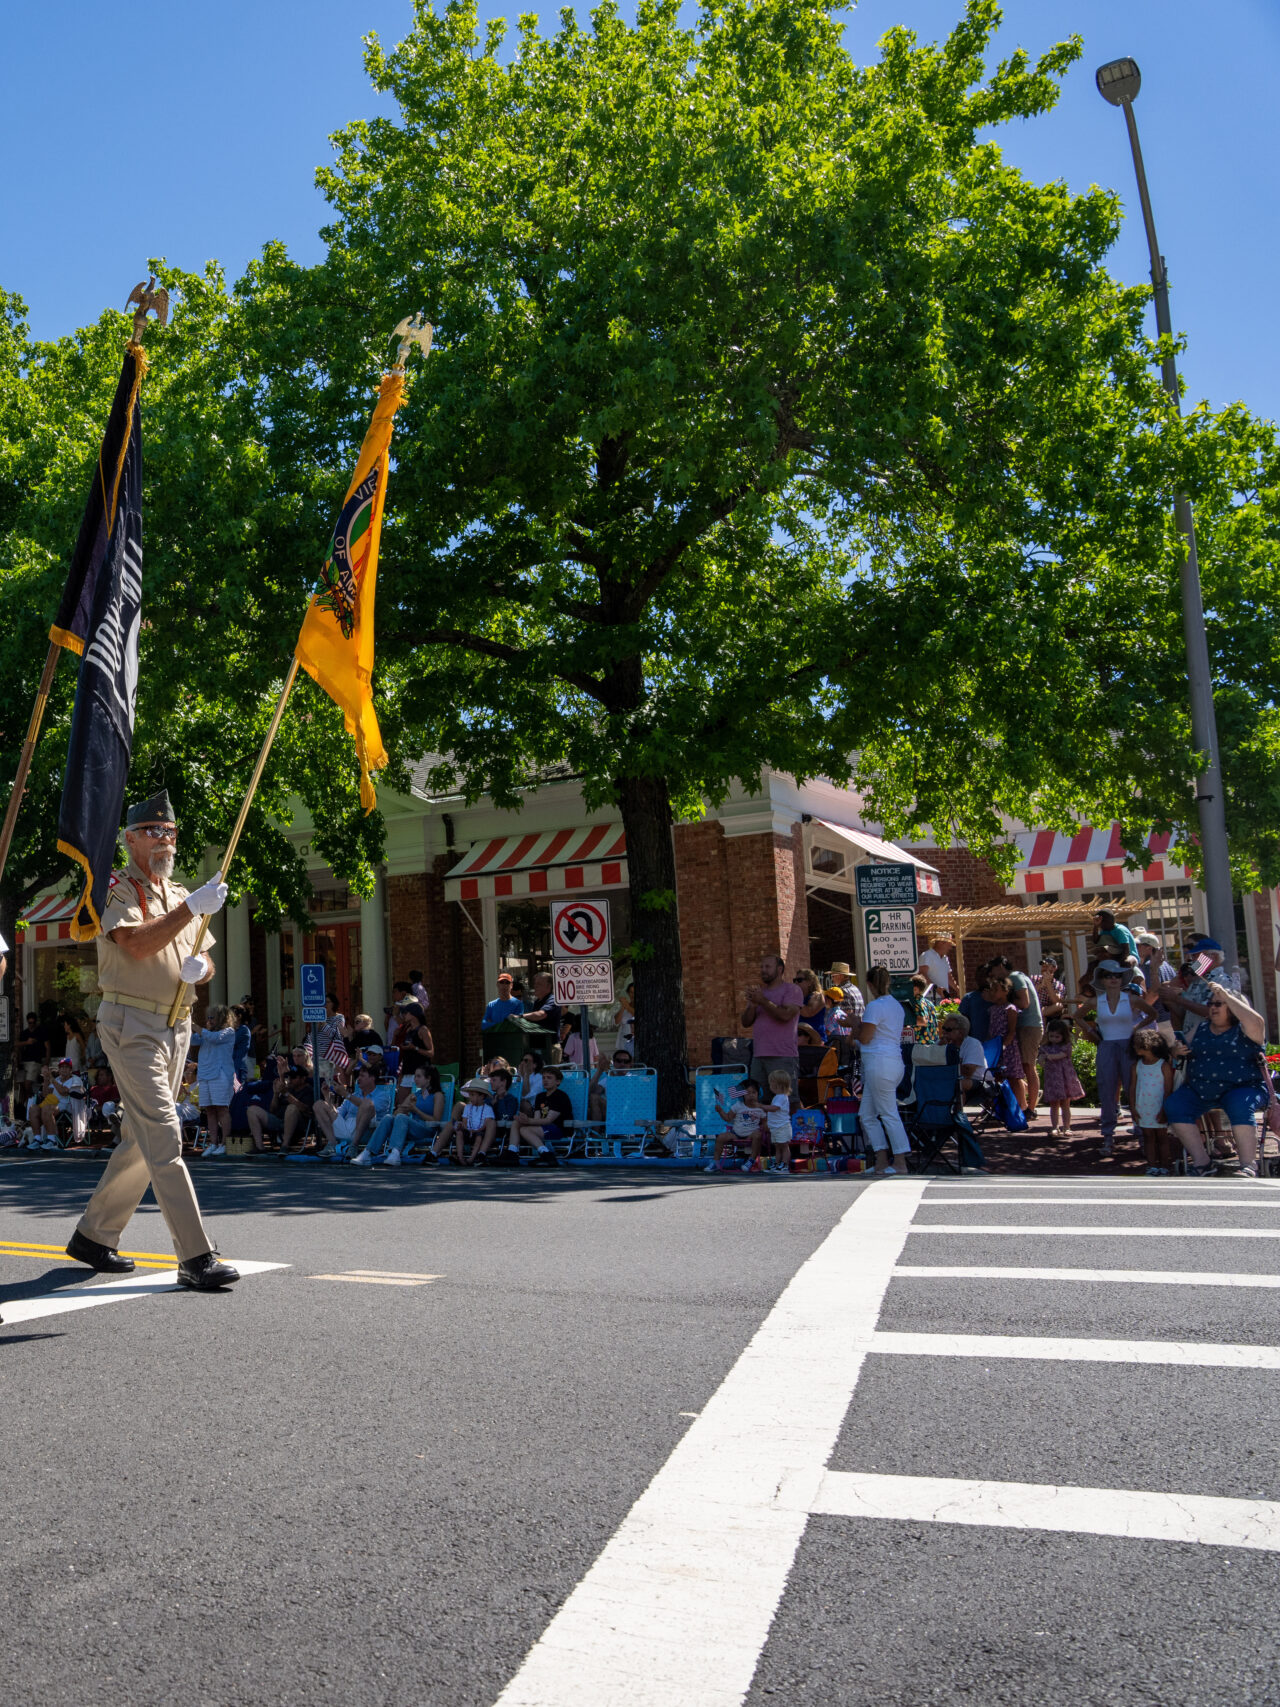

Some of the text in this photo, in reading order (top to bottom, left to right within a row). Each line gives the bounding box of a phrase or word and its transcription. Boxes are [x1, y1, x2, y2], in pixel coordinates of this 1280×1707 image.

[335, 536, 346, 560] OF
[869, 914, 879, 930] 2
[874, 958, 910, 968] THIS BLOCK
[558, 980, 576, 1000] NO
